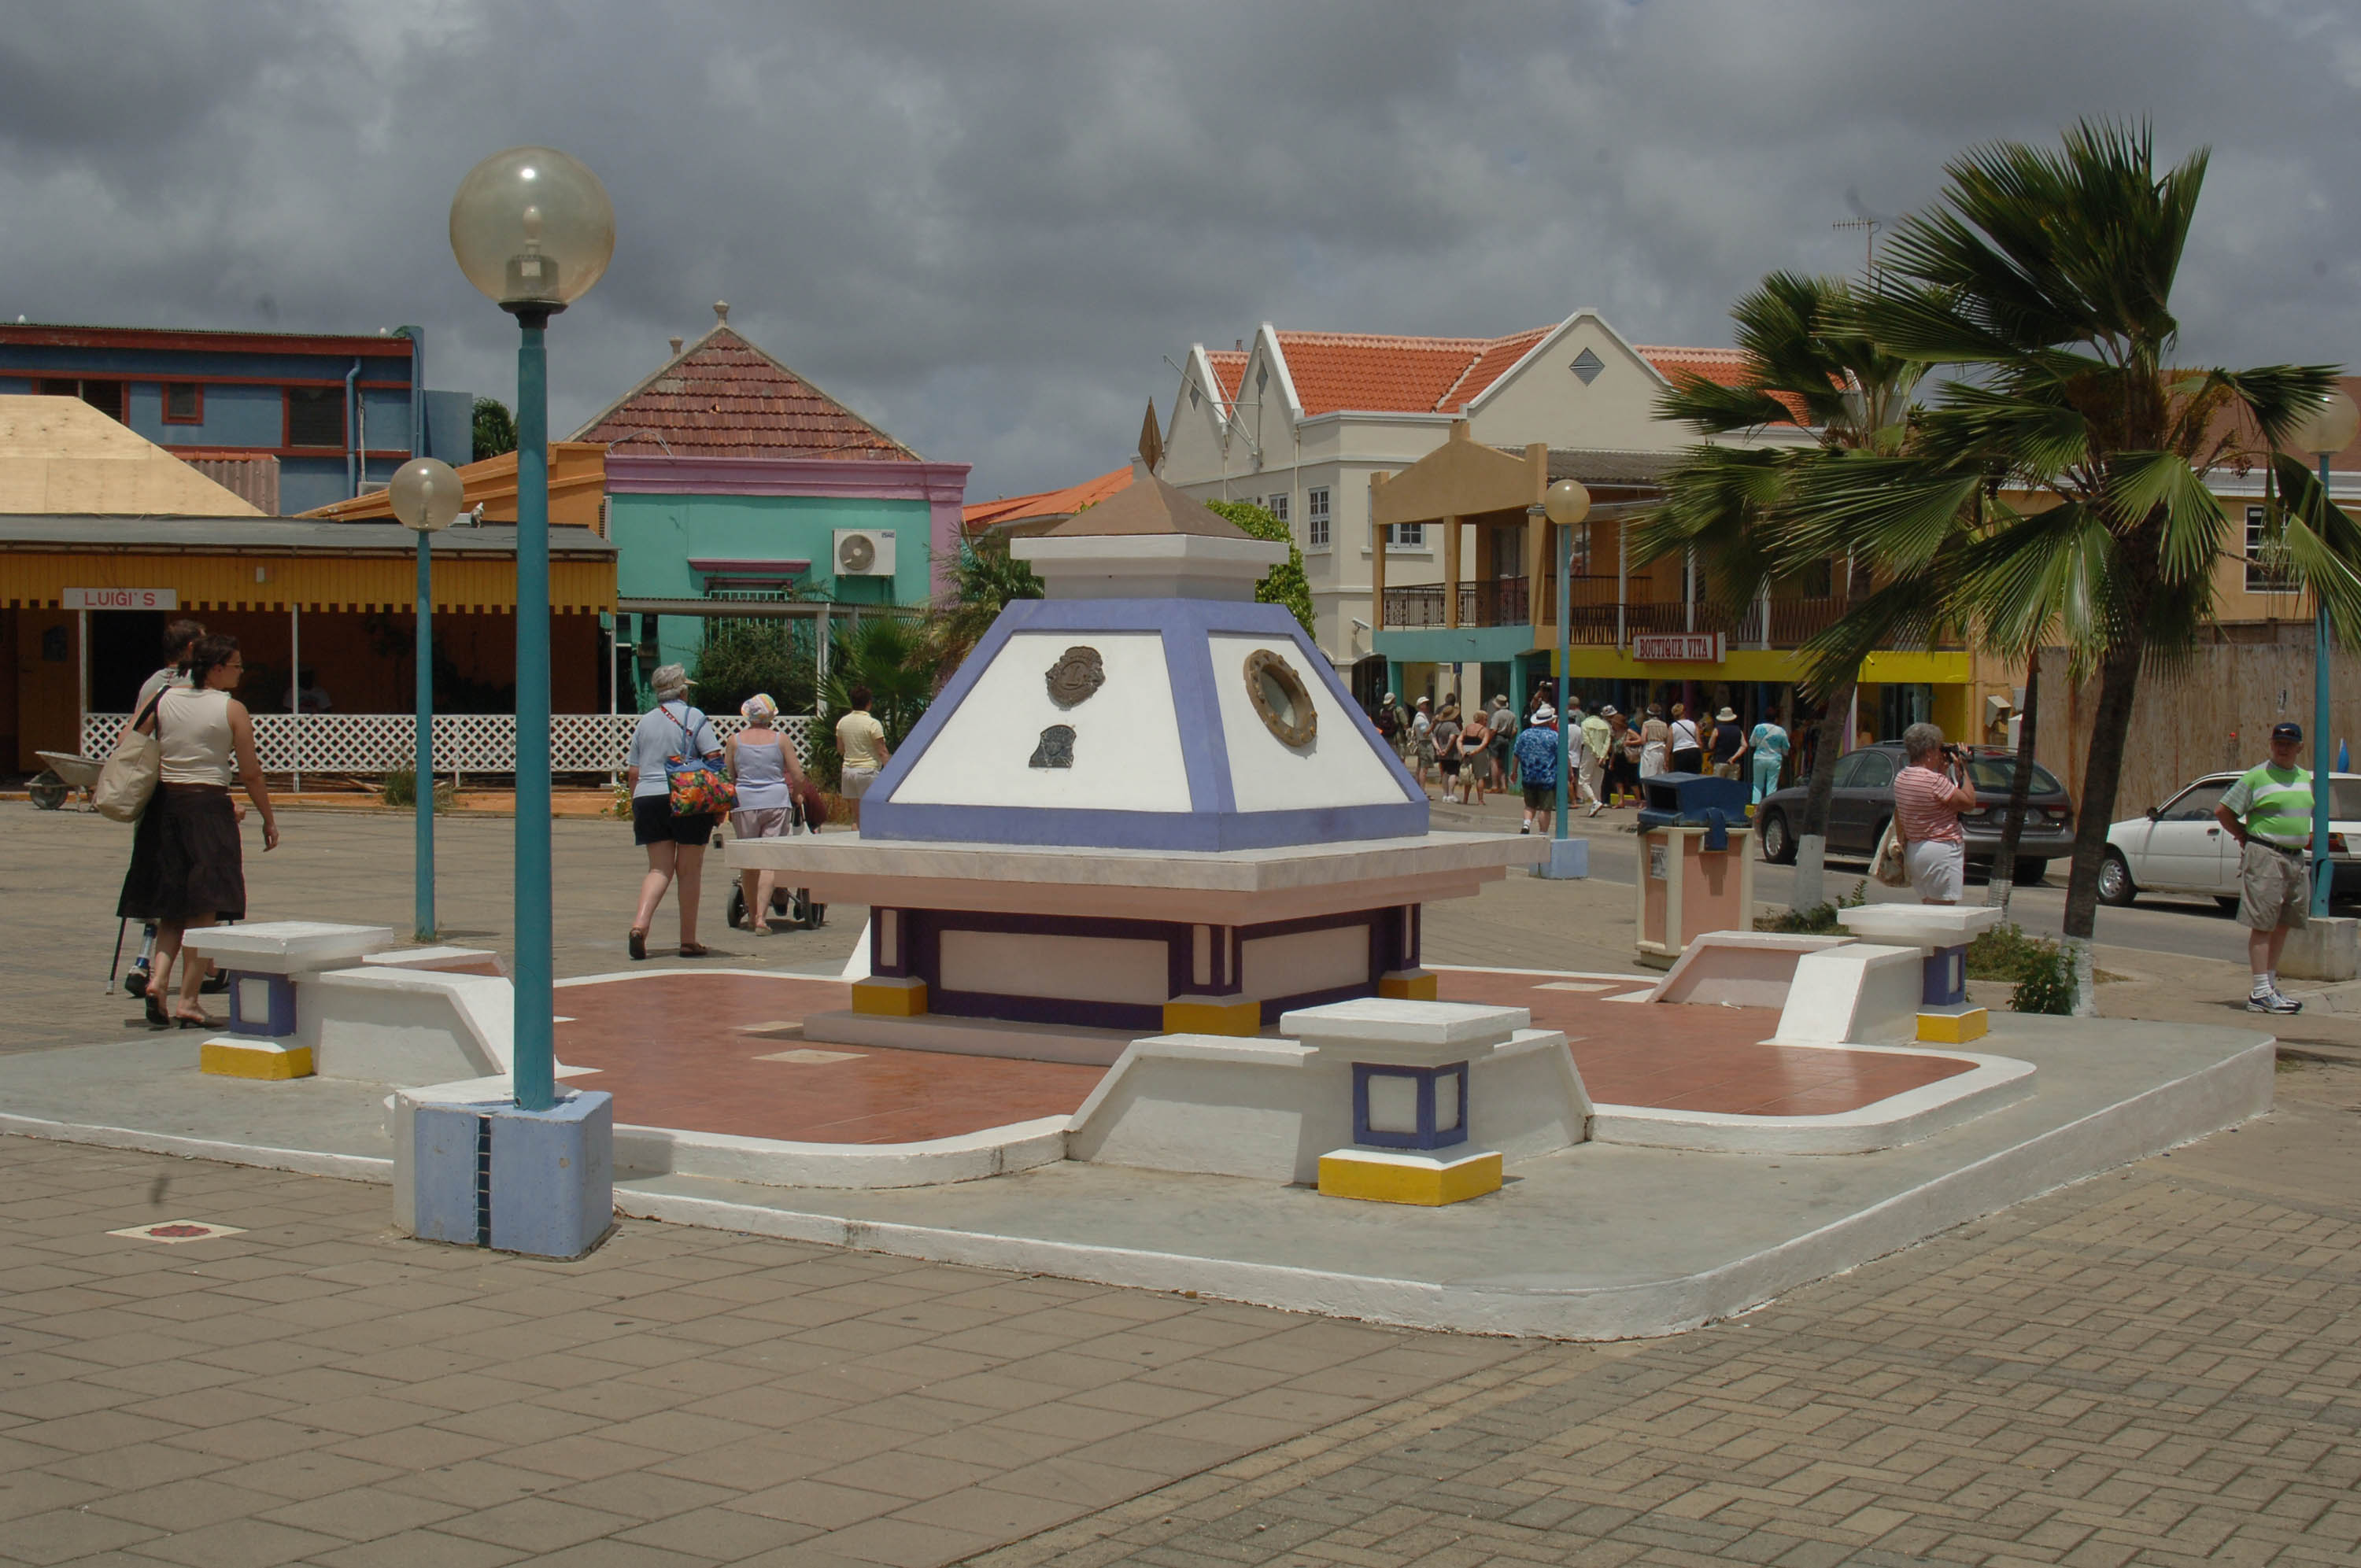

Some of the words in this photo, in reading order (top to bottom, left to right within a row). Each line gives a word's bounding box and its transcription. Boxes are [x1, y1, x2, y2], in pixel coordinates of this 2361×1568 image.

[84, 591, 156, 607] LUIGI'S
[1639, 638, 1683, 658] BOUTIQUE
[1687, 638, 1709, 657] VITA
